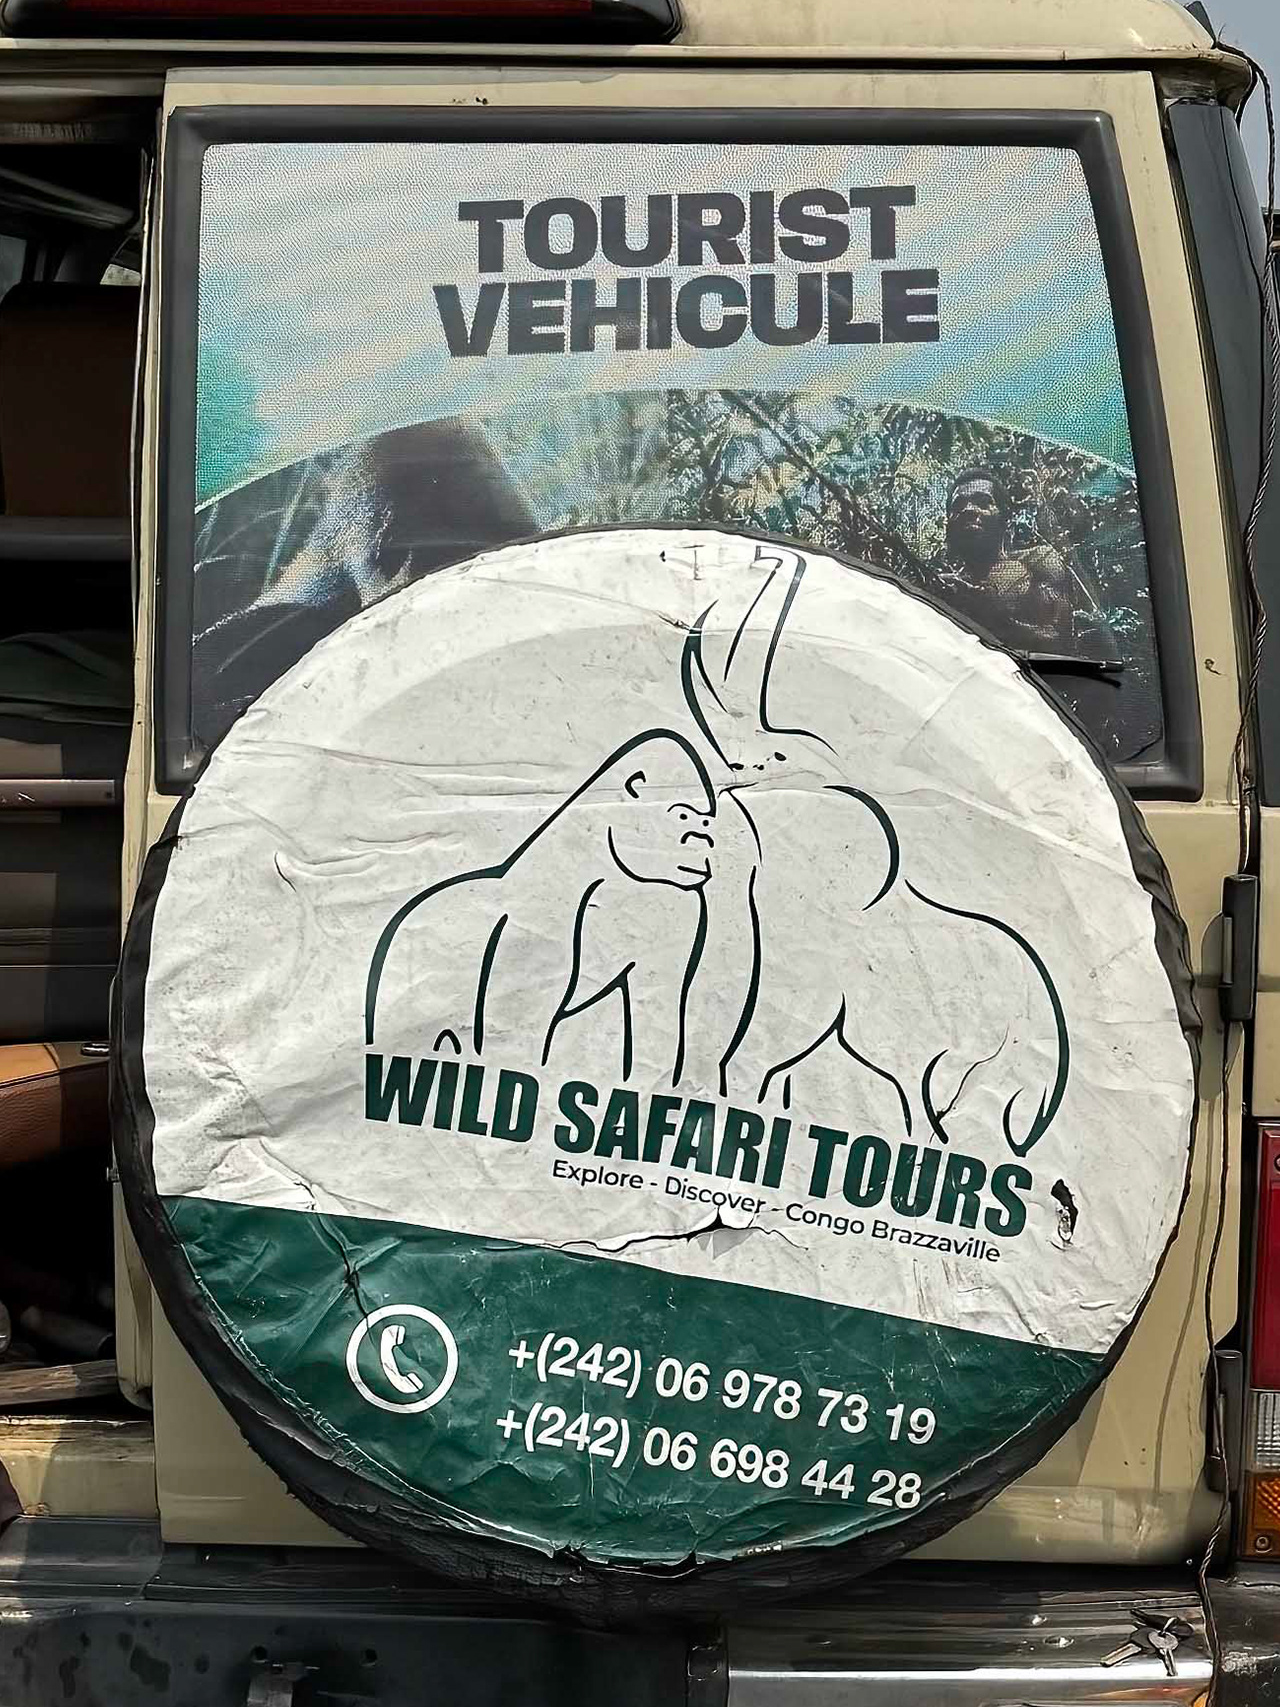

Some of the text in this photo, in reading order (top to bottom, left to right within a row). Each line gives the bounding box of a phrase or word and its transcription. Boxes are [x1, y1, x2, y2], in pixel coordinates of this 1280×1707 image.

[457, 184, 916, 274] TOURIST
[433, 269, 941, 358] VEHICULE
[365, 1052, 1033, 1238] WILD SAFARI TOURS
[552, 1159, 644, 1189] Explore
[665, 1176, 767, 1214] Discover
[785, 1203, 865, 1236] Congo
[871, 1219, 1001, 1263] Brazzaville
[507, 1332, 937, 1445] +(242) 06 978 73 19
[496, 1401, 922, 1510] +(242) 06 698 44 28
